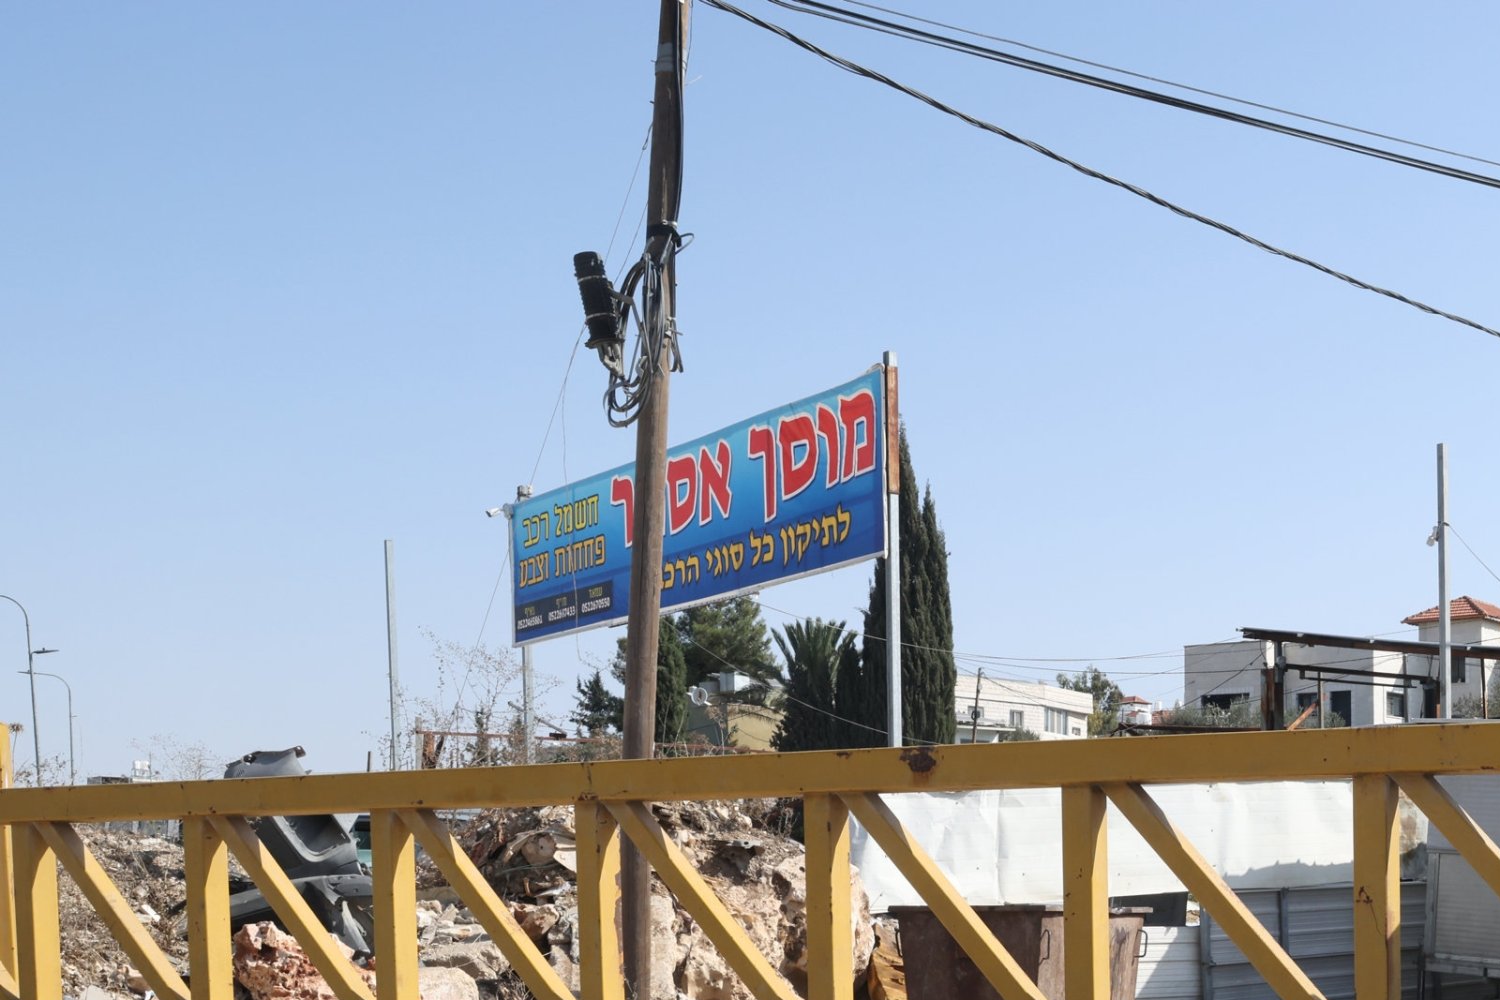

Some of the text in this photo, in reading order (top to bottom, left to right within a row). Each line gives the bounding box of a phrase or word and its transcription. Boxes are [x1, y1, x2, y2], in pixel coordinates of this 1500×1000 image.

[610, 387, 876, 549] מוסך אסר
[522, 493, 599, 549] חשמל רכב
[749, 530, 775, 567] כל
[779, 504, 850, 567] לתיקון
[519, 533, 606, 589] פחחות וצבע
[705, 540, 744, 578] סוגי
